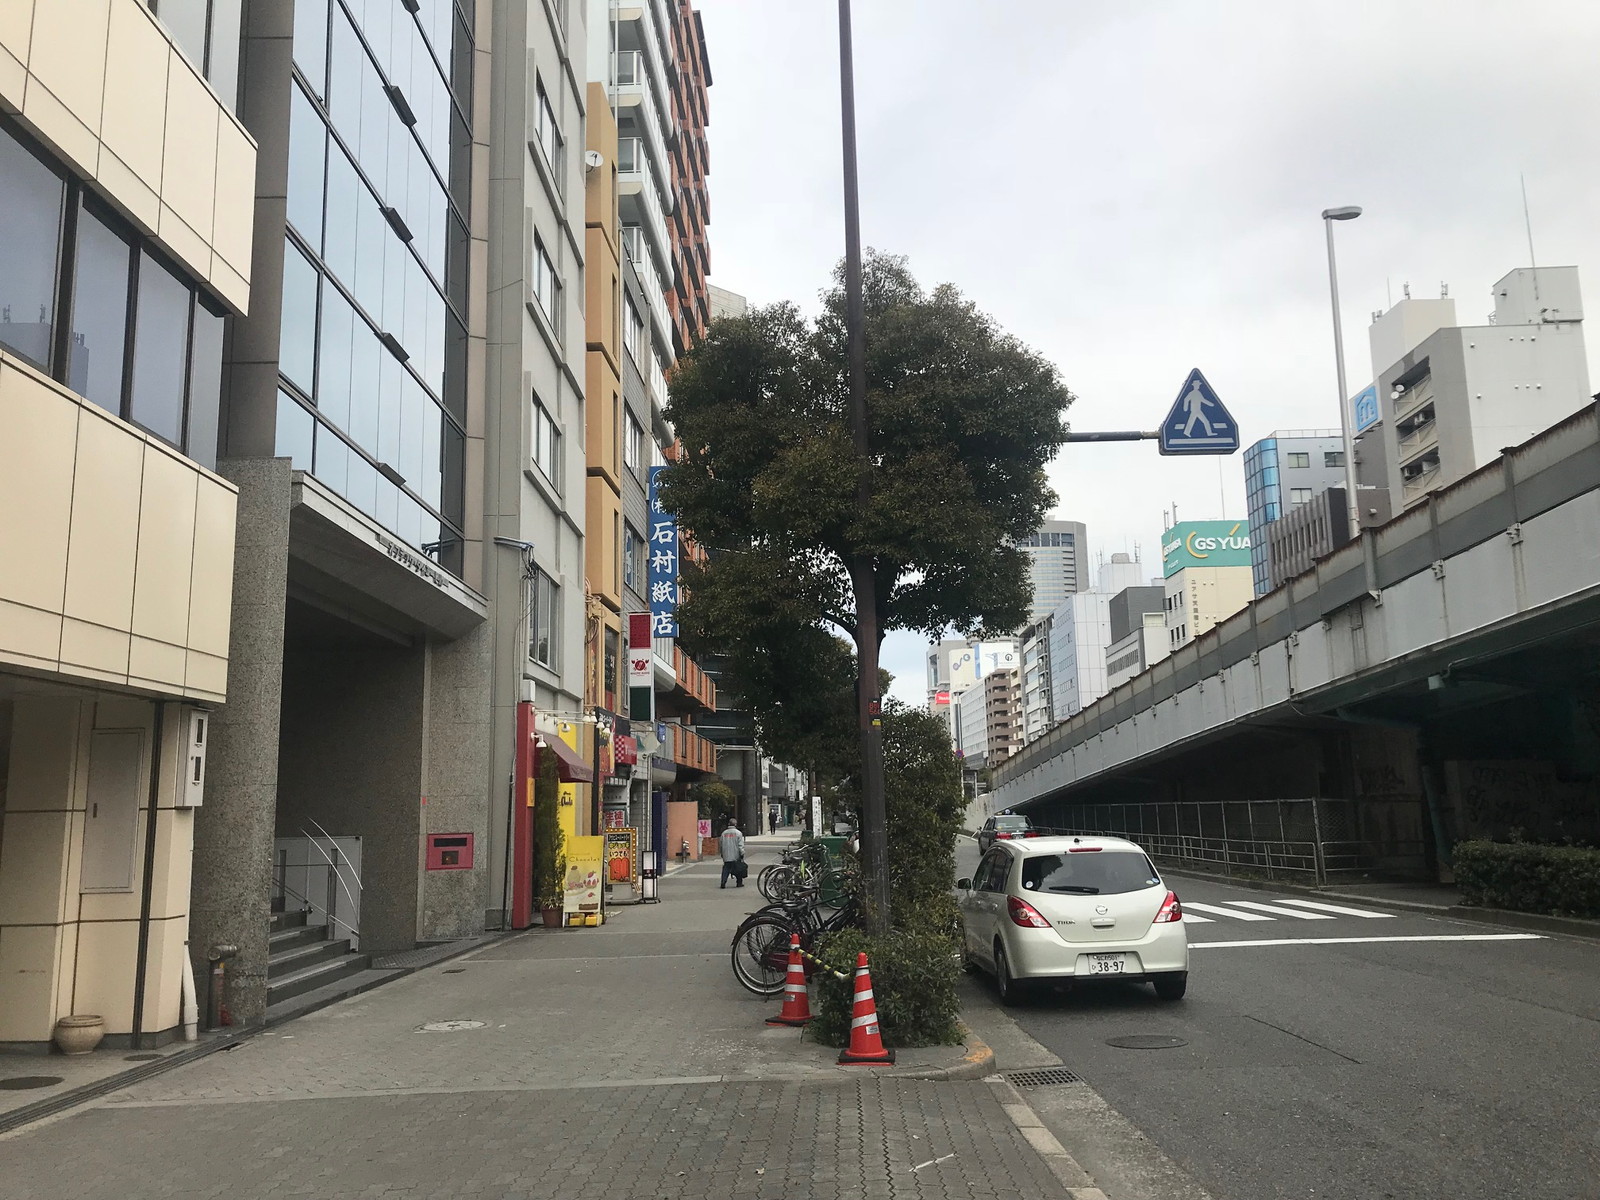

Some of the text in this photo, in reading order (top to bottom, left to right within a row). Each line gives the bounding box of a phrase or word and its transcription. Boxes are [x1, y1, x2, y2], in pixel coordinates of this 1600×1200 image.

[1194, 537, 1216, 550] GS
[651, 520, 677, 635] 石村紙店
[1097, 961, 1125, 972] 38-97
